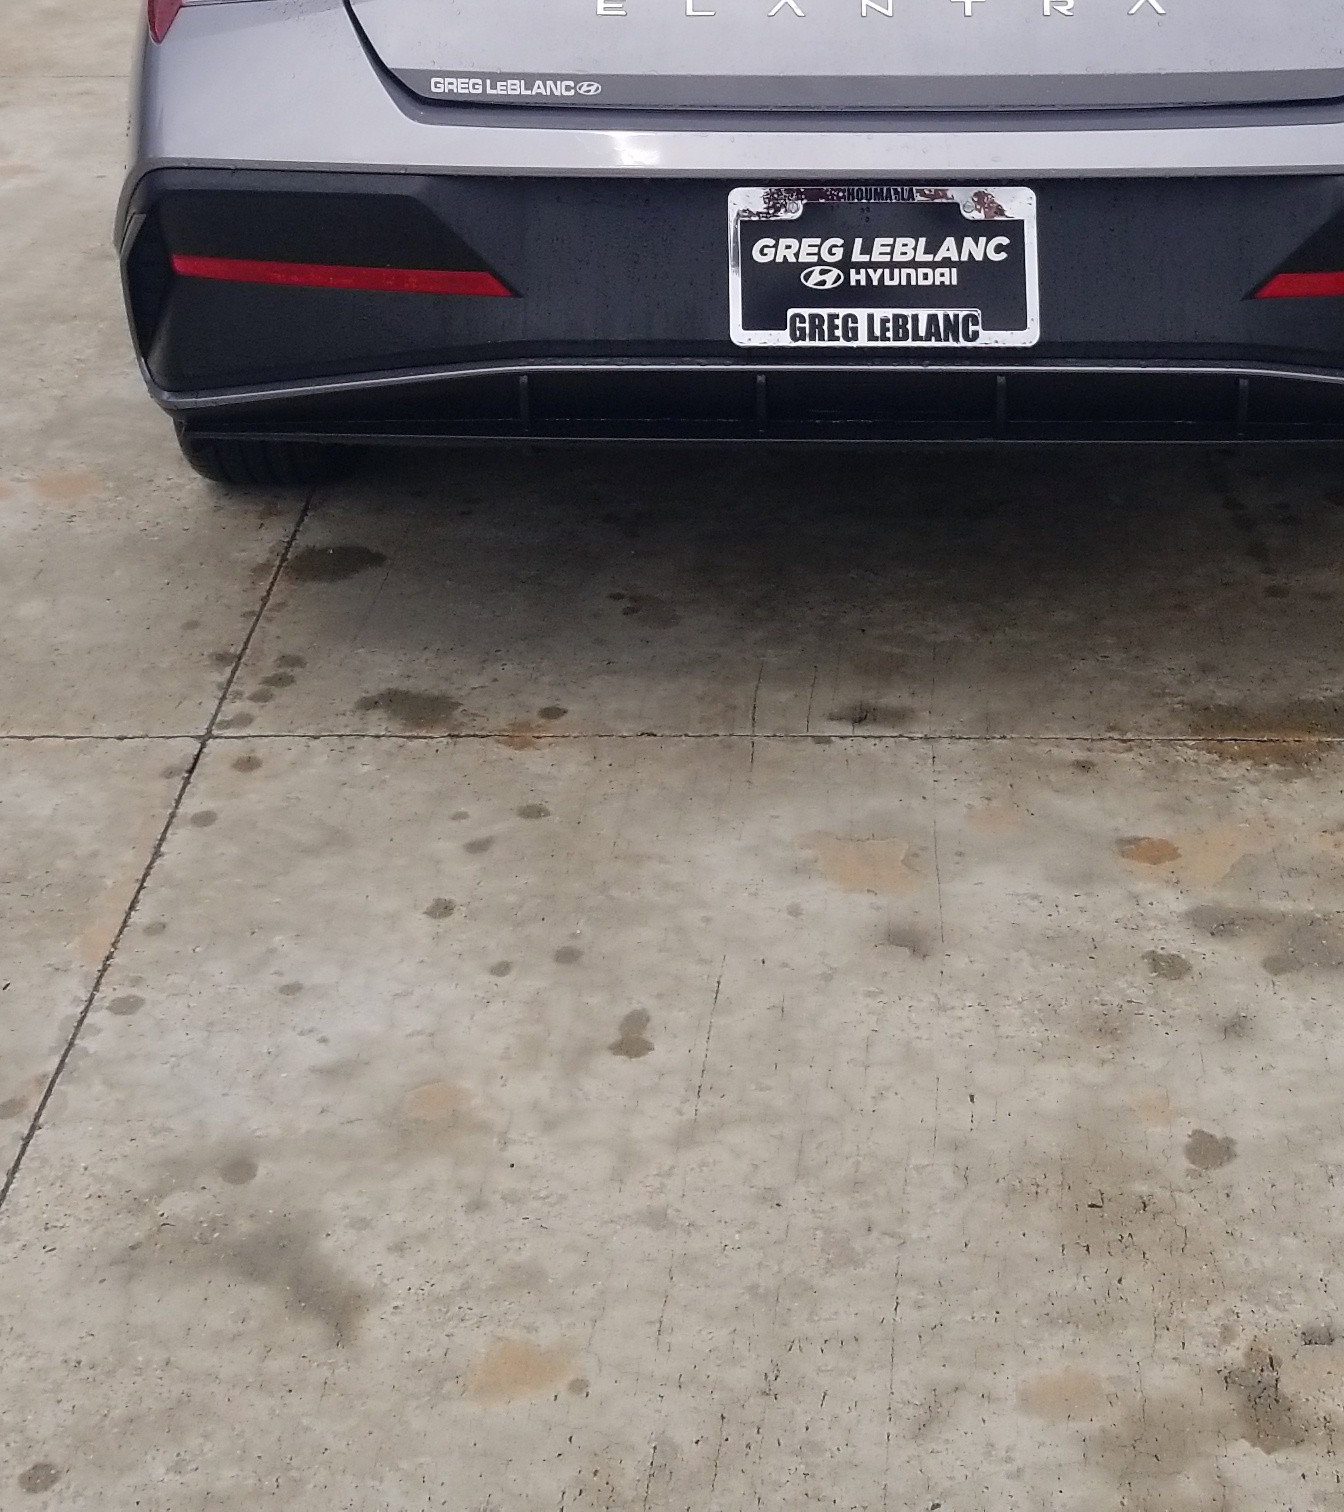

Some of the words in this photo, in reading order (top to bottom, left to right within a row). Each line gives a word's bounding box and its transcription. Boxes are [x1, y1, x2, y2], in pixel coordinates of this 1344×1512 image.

[431, 77, 482, 94] GREG
[752, 238, 844, 263] GREG
[851, 236, 1010, 262] LEBLANC
[849, 267, 958, 286] HYUNDAI
[789, 312, 859, 342] GREG
